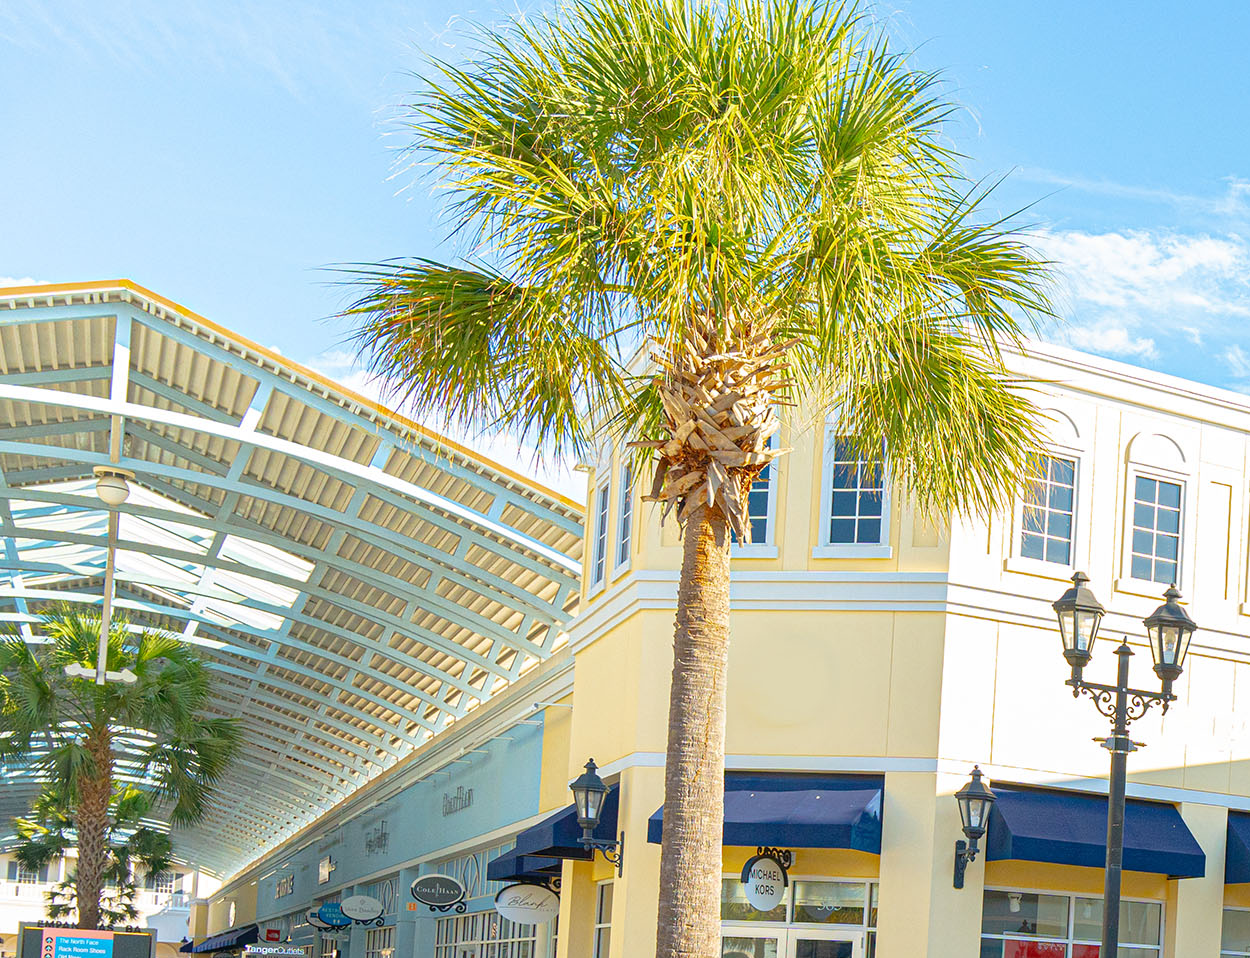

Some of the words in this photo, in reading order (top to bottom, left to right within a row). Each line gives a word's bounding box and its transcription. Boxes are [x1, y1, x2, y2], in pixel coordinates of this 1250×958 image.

[749, 869, 781, 882] MICHAEL
[755, 884, 775, 896] KORS
[507, 892, 553, 909] Blank
[37, 919, 115, 932] EMPANAS
